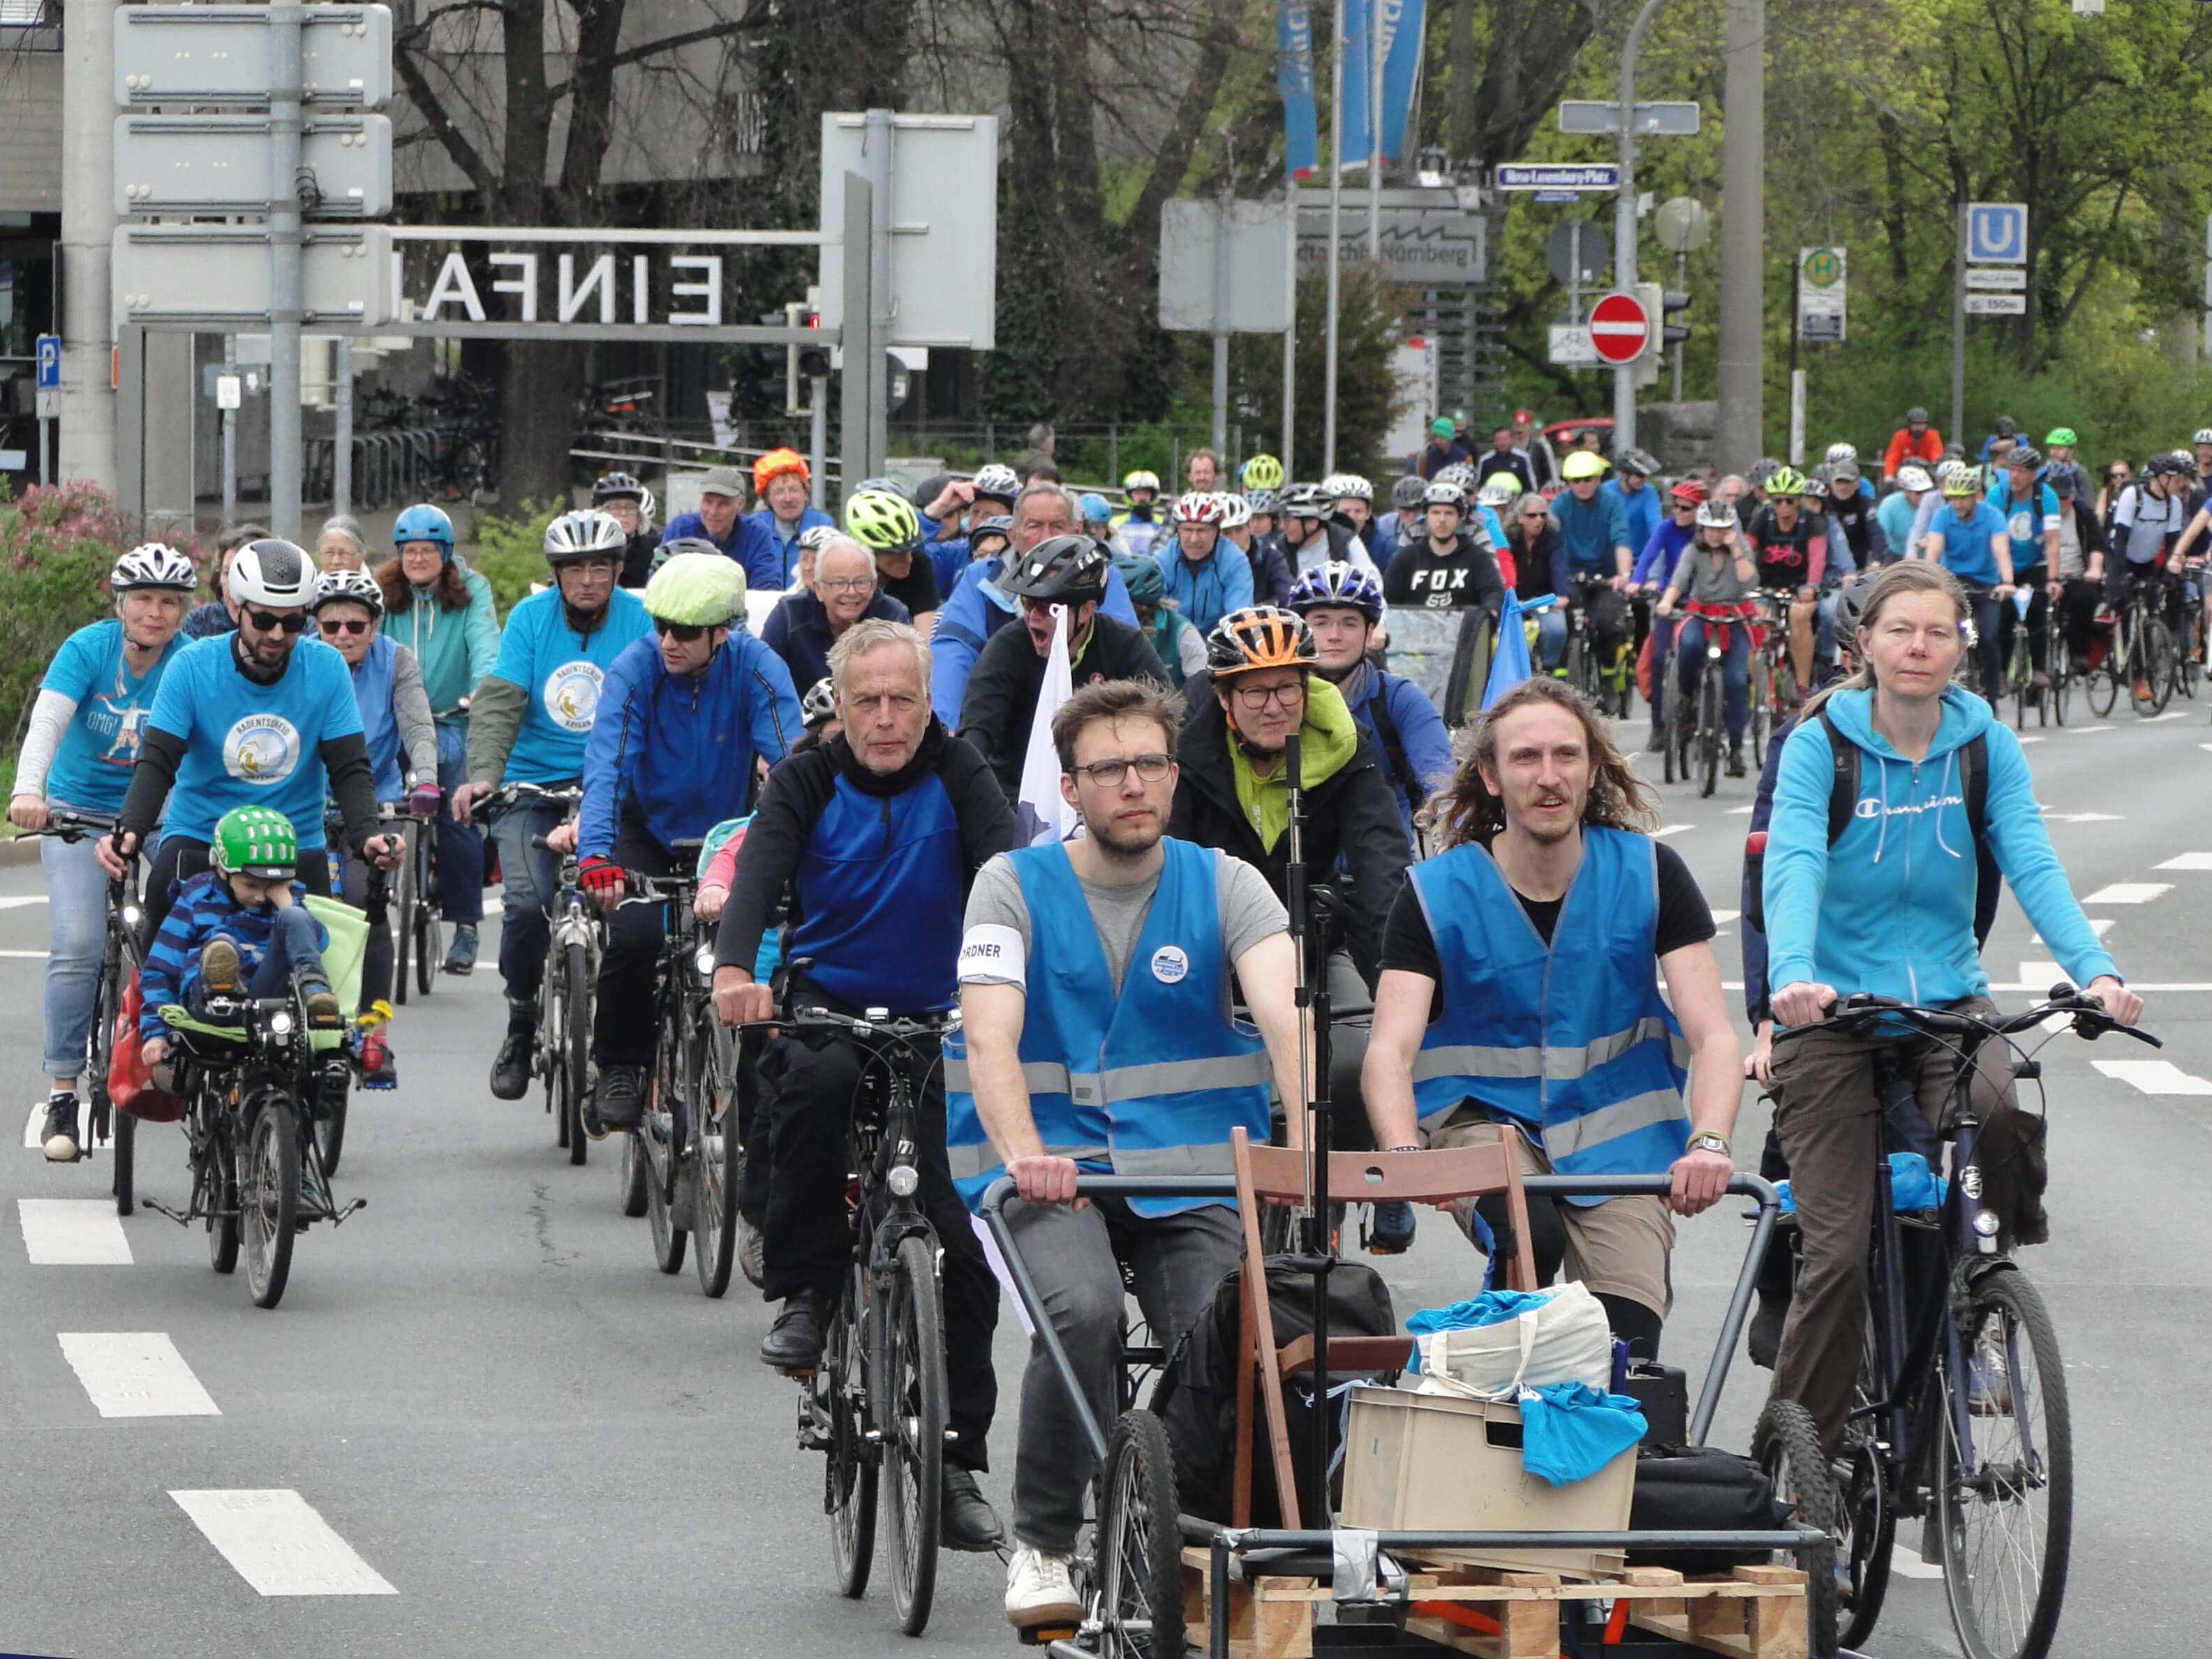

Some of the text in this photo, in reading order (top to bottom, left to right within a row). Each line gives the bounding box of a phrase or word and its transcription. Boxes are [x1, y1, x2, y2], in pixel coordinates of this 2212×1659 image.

[1980, 213, 2013, 253] U
[1815, 257, 1832, 277] H
[1987, 299, 2018, 310] 150m
[43, 343, 55, 382] P
[1411, 569, 1469, 590] FOX
[87, 711, 118, 737] OMG!
